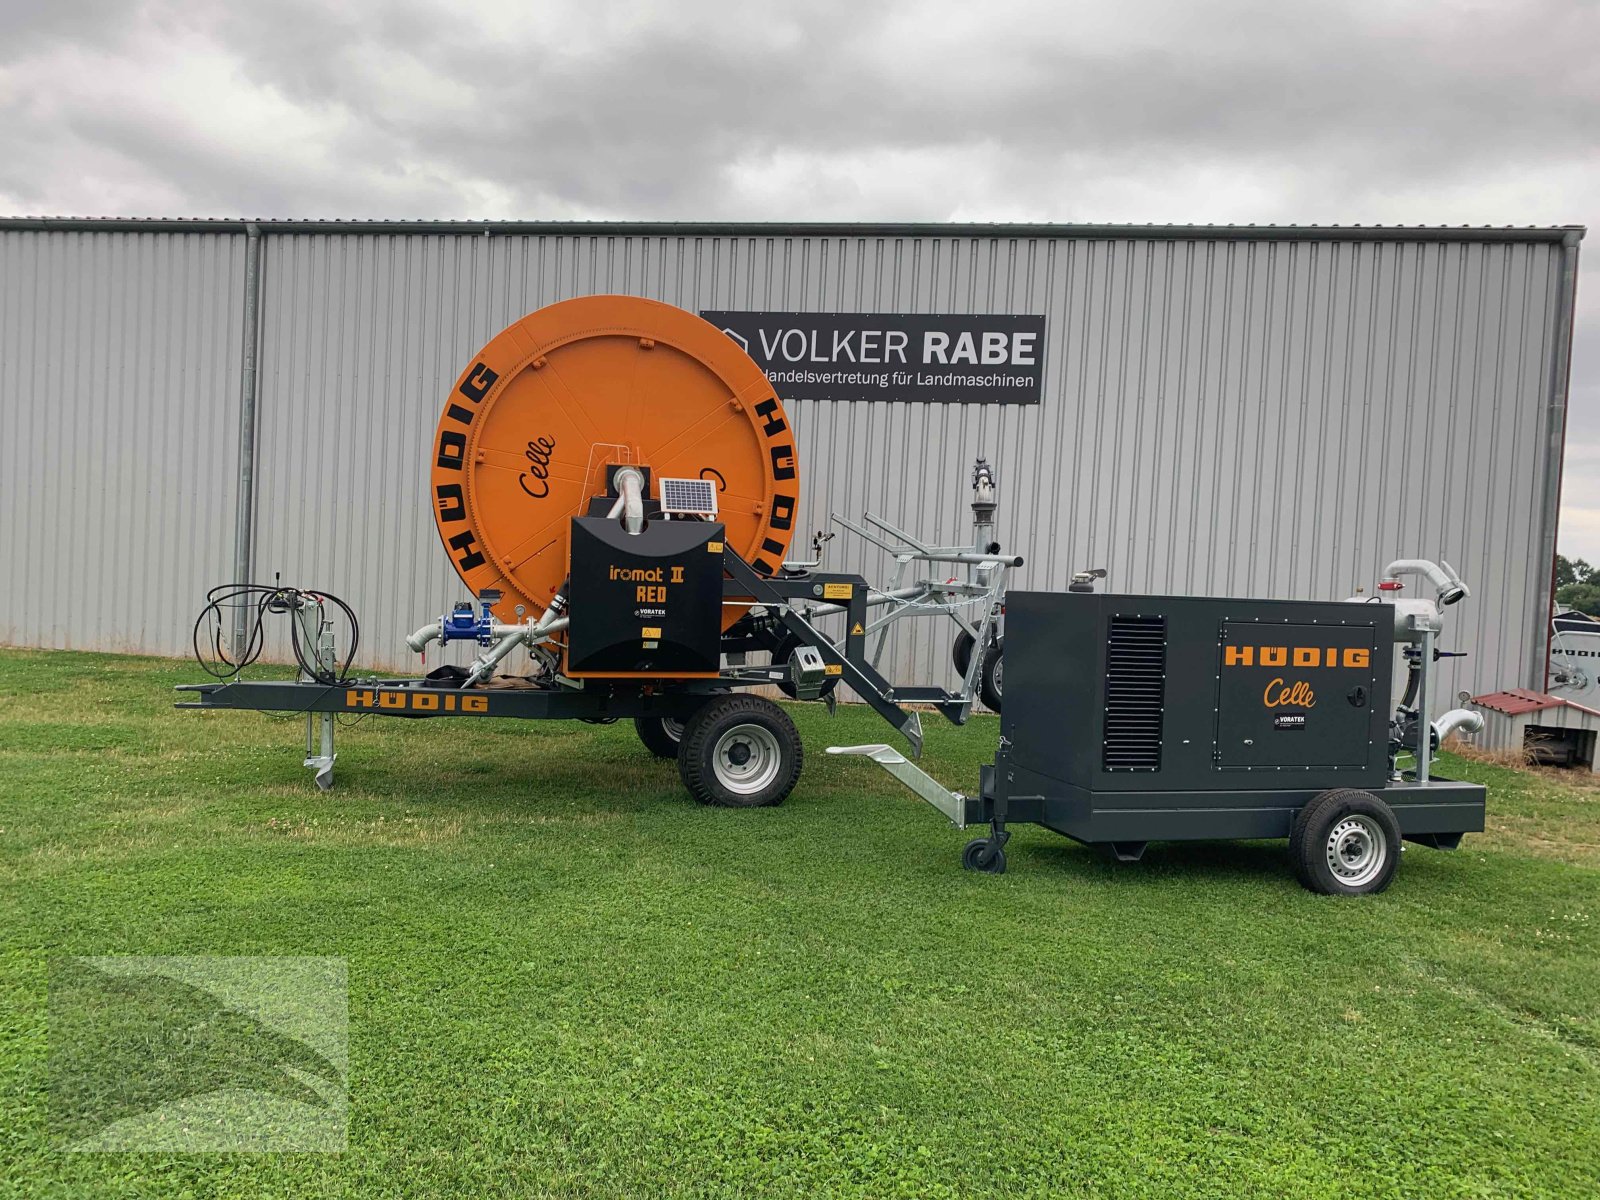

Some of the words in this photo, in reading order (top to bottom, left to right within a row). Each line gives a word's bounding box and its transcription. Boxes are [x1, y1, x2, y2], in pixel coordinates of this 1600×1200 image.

[758, 328, 908, 363] VOLKER
[922, 331, 1037, 364] RABE
[892, 371, 913, 387] für
[916, 372, 1035, 388] Landmaschinen
[436, 362, 500, 573] HÜDIG
[519, 434, 556, 499] Celle
[609, 565, 663, 582] iromat
[671, 566, 684, 583] II
[636, 586, 667, 603] RED
[1225, 646, 1369, 667] HÜDIG
[346, 690, 488, 712] HÜDIG
[1263, 677, 1317, 708] Celle
